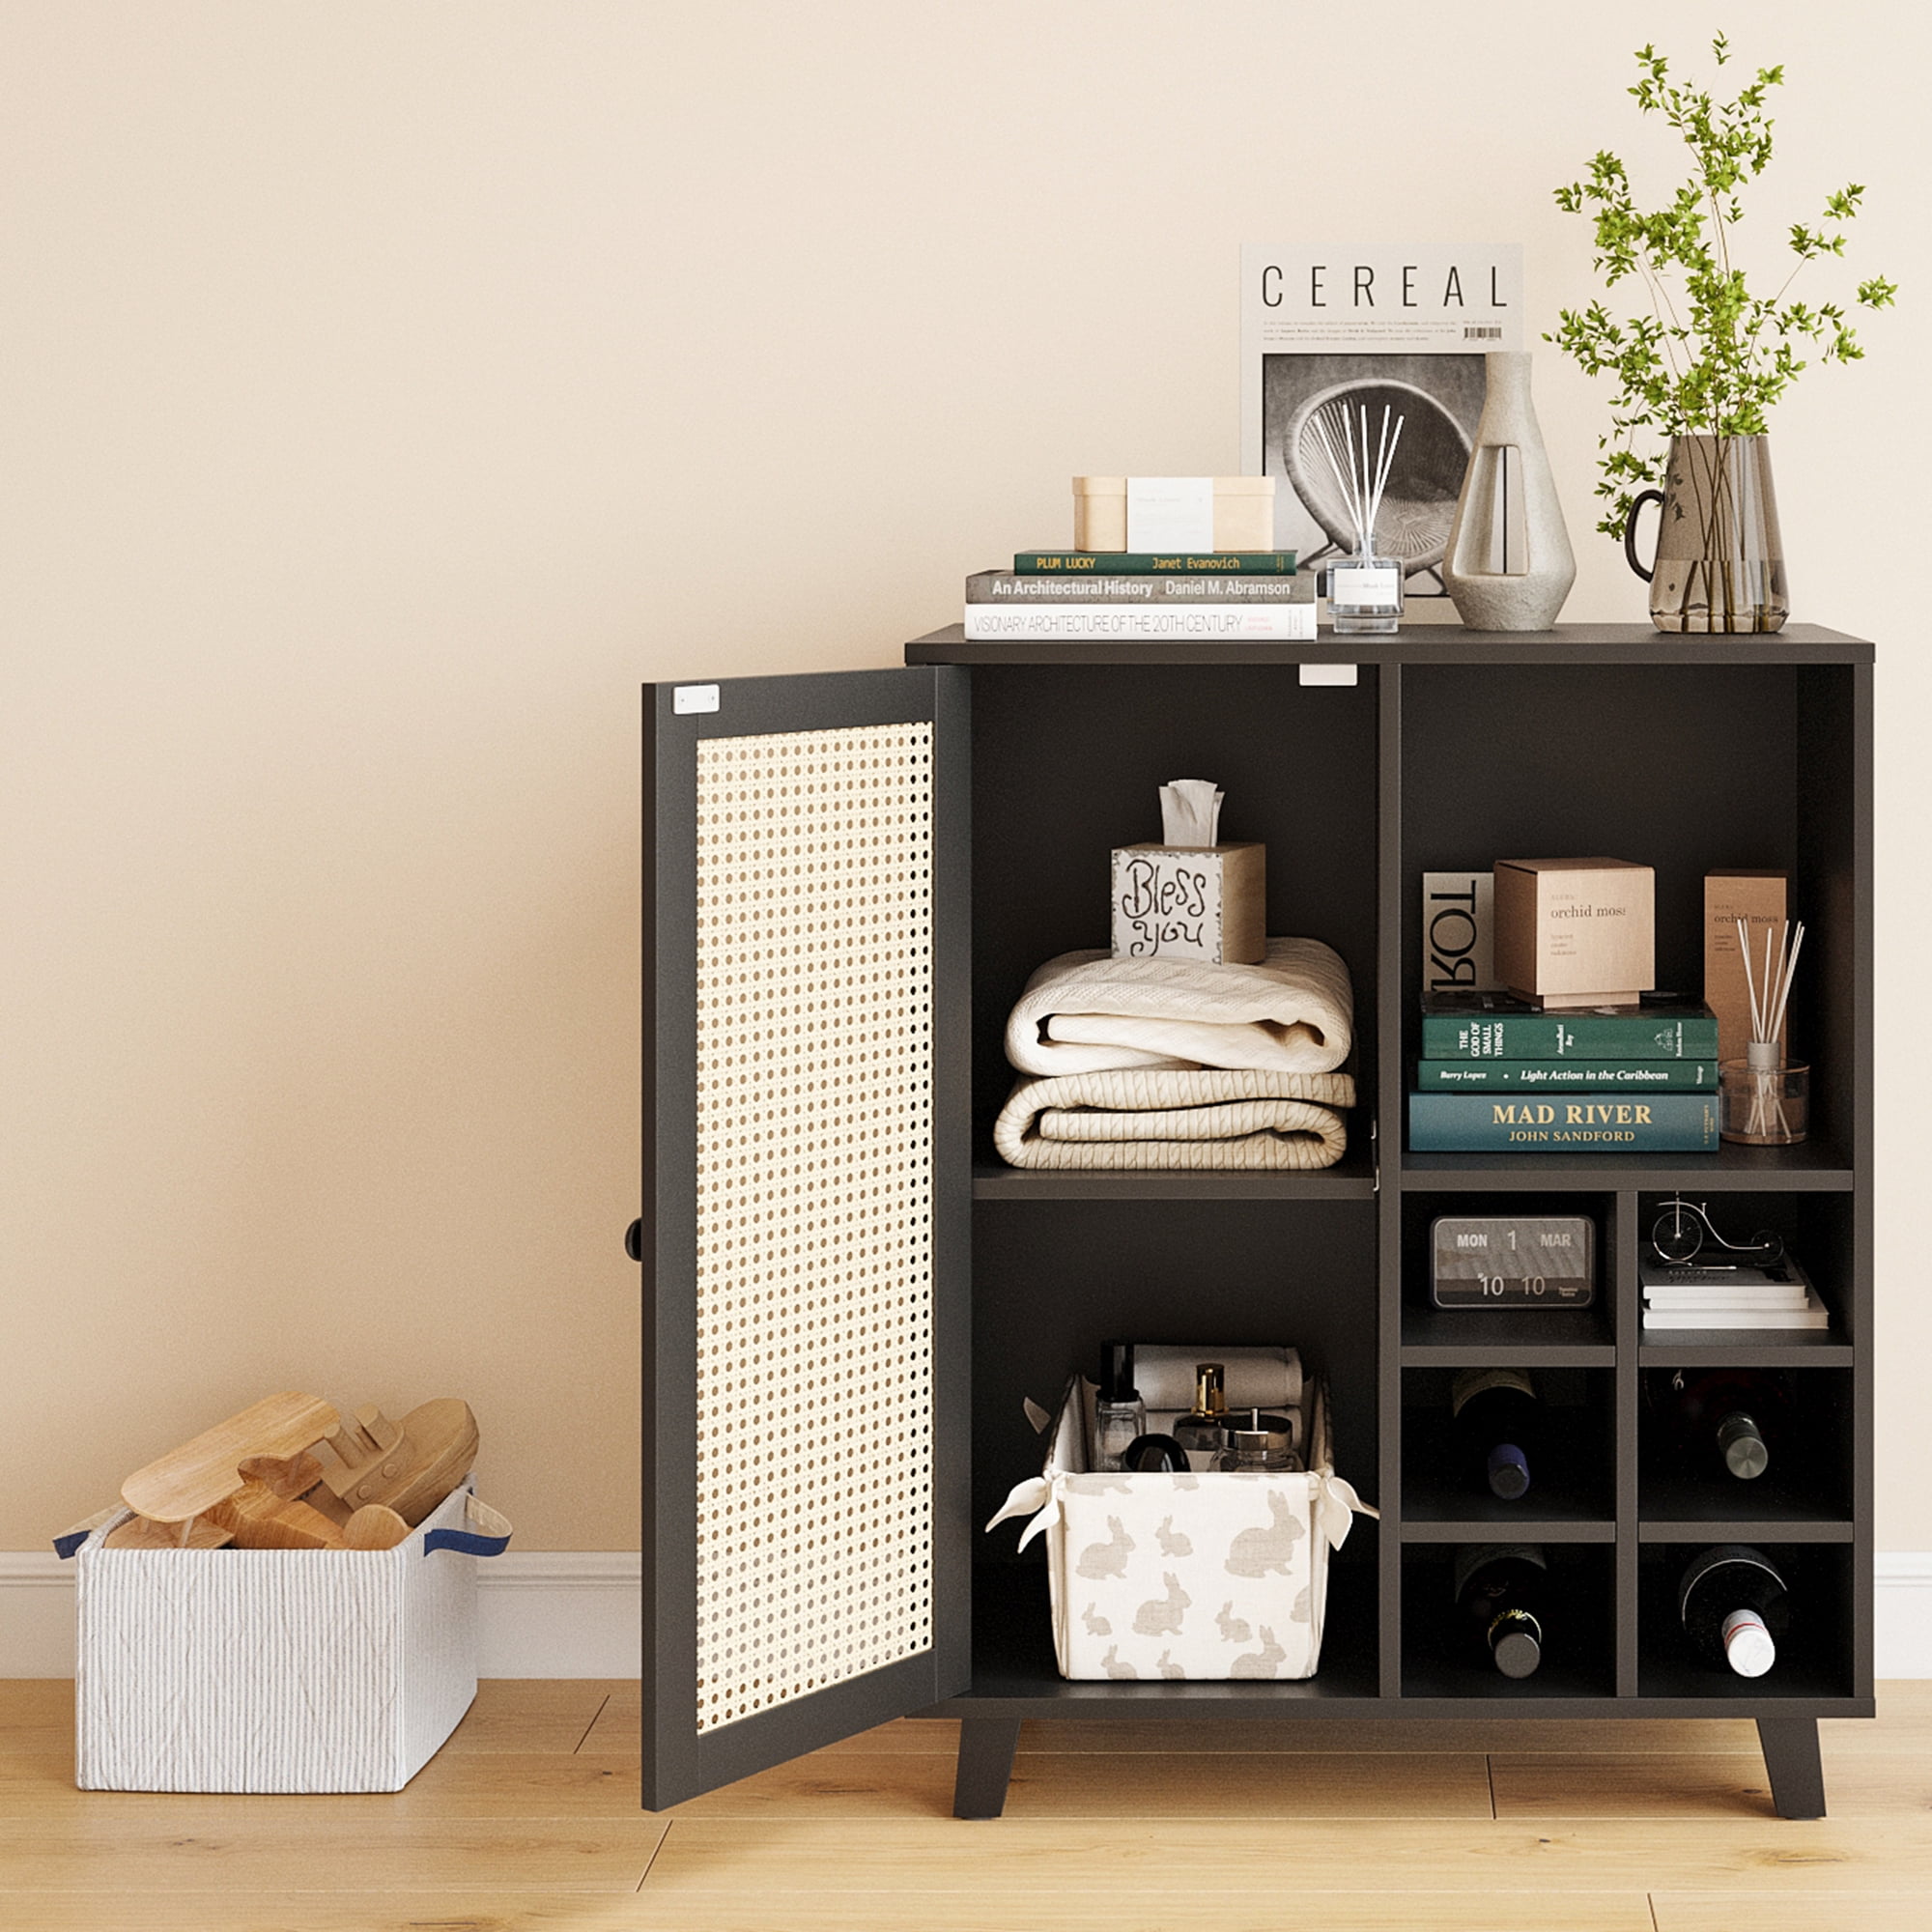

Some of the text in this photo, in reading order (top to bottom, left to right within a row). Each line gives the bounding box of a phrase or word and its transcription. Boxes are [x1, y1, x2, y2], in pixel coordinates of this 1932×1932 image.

[1263, 265, 1508, 307] CEREAL
[1037, 556, 1096, 569] PLUM LUCKY
[1152, 556, 1240, 570] Janet Evanovich
[992, 580, 1153, 597] An Architectural History
[1165, 581, 1291, 595] Daniel M. Abramson
[974, 614, 1244, 632] VISIONARY ARCHITECTURE OF THE 20TH CENTURY
[1122, 858, 1207, 919] Bless
[1550, 904, 1592, 919] orchid
[1714, 912, 1778, 923] orchid moss
[1459, 1030, 1468, 1050] THE
[1470, 1021, 1480, 1057] GOD OF
[1483, 1024, 1492, 1055] SMALL
[1494, 1022, 1503, 1057] THINGS
[1520, 1069, 1669, 1083] Light Action in the Caribbean
[1492, 1104, 1653, 1124] MAD RIVER
[1509, 1130, 1635, 1142] JOHN SANDFORD
[1457, 1230, 1572, 1251] MON 1 MAR
[1479, 1275, 1505, 1296] 10
[1521, 1275, 1546, 1296] 10
